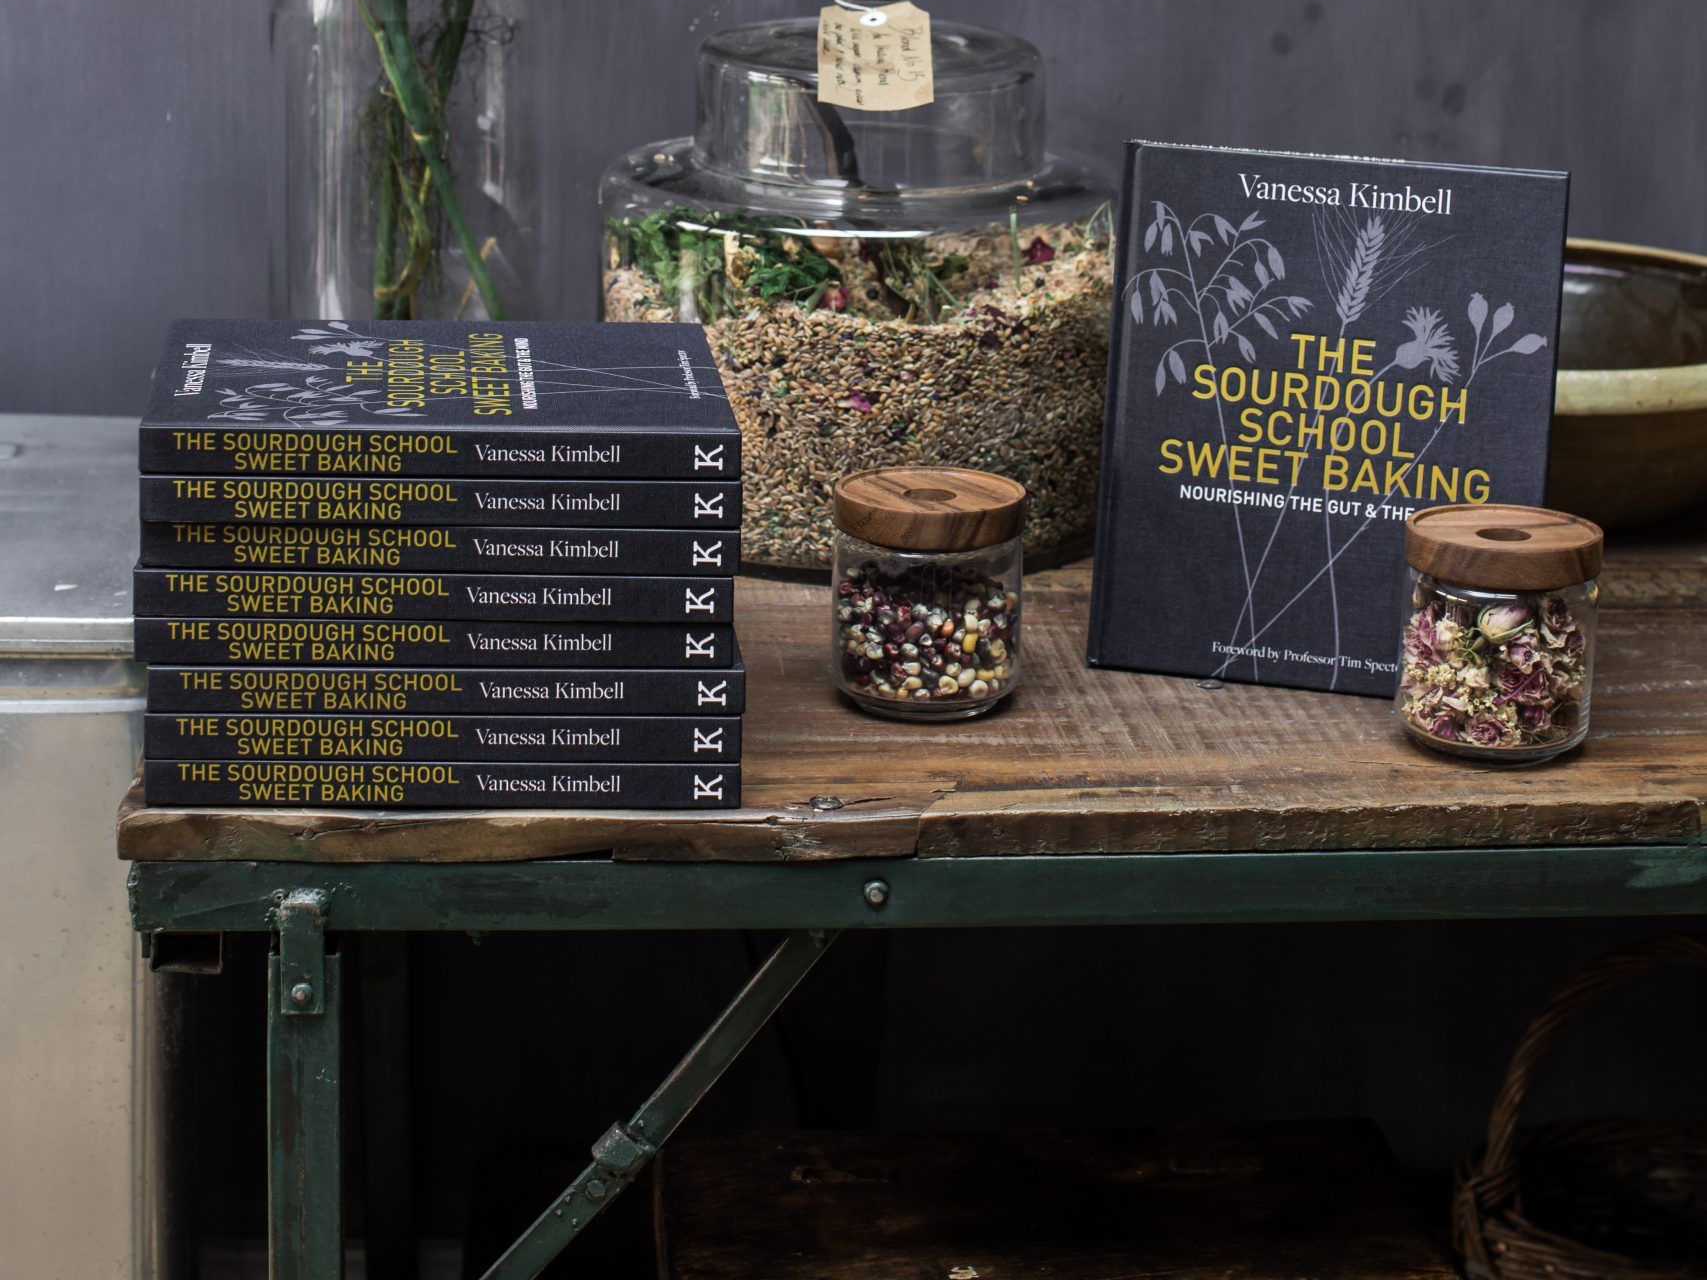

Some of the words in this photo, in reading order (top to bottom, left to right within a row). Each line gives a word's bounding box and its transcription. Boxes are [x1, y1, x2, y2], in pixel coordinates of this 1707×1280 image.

[1238, 173, 1341, 206] Vanessa
[1348, 181, 1452, 215] Kimbell
[181, 343, 212, 369] Kimbell
[468, 333, 508, 374] BAKING
[1290, 333, 1377, 376] THE
[345, 361, 383, 383] THE
[386, 339, 426, 408] SOURDOUGH
[429, 350, 468, 395] SCHOOL
[173, 370, 207, 397] Vanessa
[1191, 364, 1469, 424] SOURDOUGH
[471, 376, 512, 416] SWEET
[172, 431, 216, 451] THE
[223, 432, 362, 453] SOURDOUGH
[369, 434, 458, 454] SCHOOL
[1237, 408, 1416, 459] SCHOOL
[234, 452, 311, 471] SWEET
[317, 453, 402, 473] BAKING
[475, 444, 546, 462] Vanessa
[551, 444, 620, 463] Kimbell
[1158, 438, 1309, 487] SWEET
[1322, 454, 1492, 505] BAKING
[172, 479, 217, 499] THE
[223, 480, 362, 501] SOURDOUGH
[369, 482, 458, 502] SCHOOL
[475, 492, 545, 510] Vanessa
[551, 492, 620, 511] Kimbell
[1179, 484, 1285, 509] NOURISHING
[1290, 495, 1323, 513] THE
[1327, 499, 1362, 518] GUT
[1365, 503, 1377, 519] &
[234, 500, 311, 520] SWEET
[317, 501, 402, 521] BAKING
[174, 524, 216, 543] THE
[223, 526, 361, 546] SOURDOUGH
[368, 528, 457, 548] SCHOOL
[234, 544, 310, 564] SWEET
[317, 546, 401, 566] BAKING
[473, 538, 544, 557] Vanessa
[549, 540, 619, 558] Kimbell
[165, 573, 209, 593] THE
[215, 574, 354, 595] SOURDOUGH
[360, 576, 449, 597] SCHOOL
[466, 586, 537, 605] Vanessa
[542, 587, 612, 606] Kimbell
[227, 594, 303, 613] SWEET
[309, 595, 394, 615] BAKING
[166, 621, 211, 641] THE
[217, 622, 355, 642] SOURDOUGH
[362, 623, 450, 643] SCHOOL
[467, 633, 538, 651] Vanessa
[543, 633, 612, 651] Kimbell
[228, 641, 305, 661] SWEET
[311, 642, 395, 662] BAKING
[1212, 641, 1266, 658] Foreword
[1267, 647, 1282, 663] by
[1284, 649, 1337, 666] Professor
[1338, 655, 1362, 669] Tim
[179, 671, 222, 691] THE
[229, 672, 367, 691] SOURDOUGH
[374, 673, 462, 692] SCHOOL
[479, 681, 550, 699] Vanessa
[555, 681, 624, 699] Kimbell
[240, 691, 317, 710] SWEET
[323, 691, 407, 710] BAKING
[175, 717, 219, 737] THE
[225, 718, 363, 738] SOURDOUGH
[370, 719, 459, 738] SCHOOL
[475, 728, 546, 746] Vanessa
[551, 728, 620, 746] Kimbell
[237, 737, 313, 756] SWEET
[319, 737, 404, 757] BAKING
[177, 763, 221, 782] THE
[227, 763, 365, 783] SOURDOUGH
[371, 765, 460, 785] SCHOOL
[476, 774, 546, 792] Vanessa
[552, 774, 621, 793] Kimbell
[238, 782, 315, 801] SWEET
[321, 783, 404, 803] BAKING
